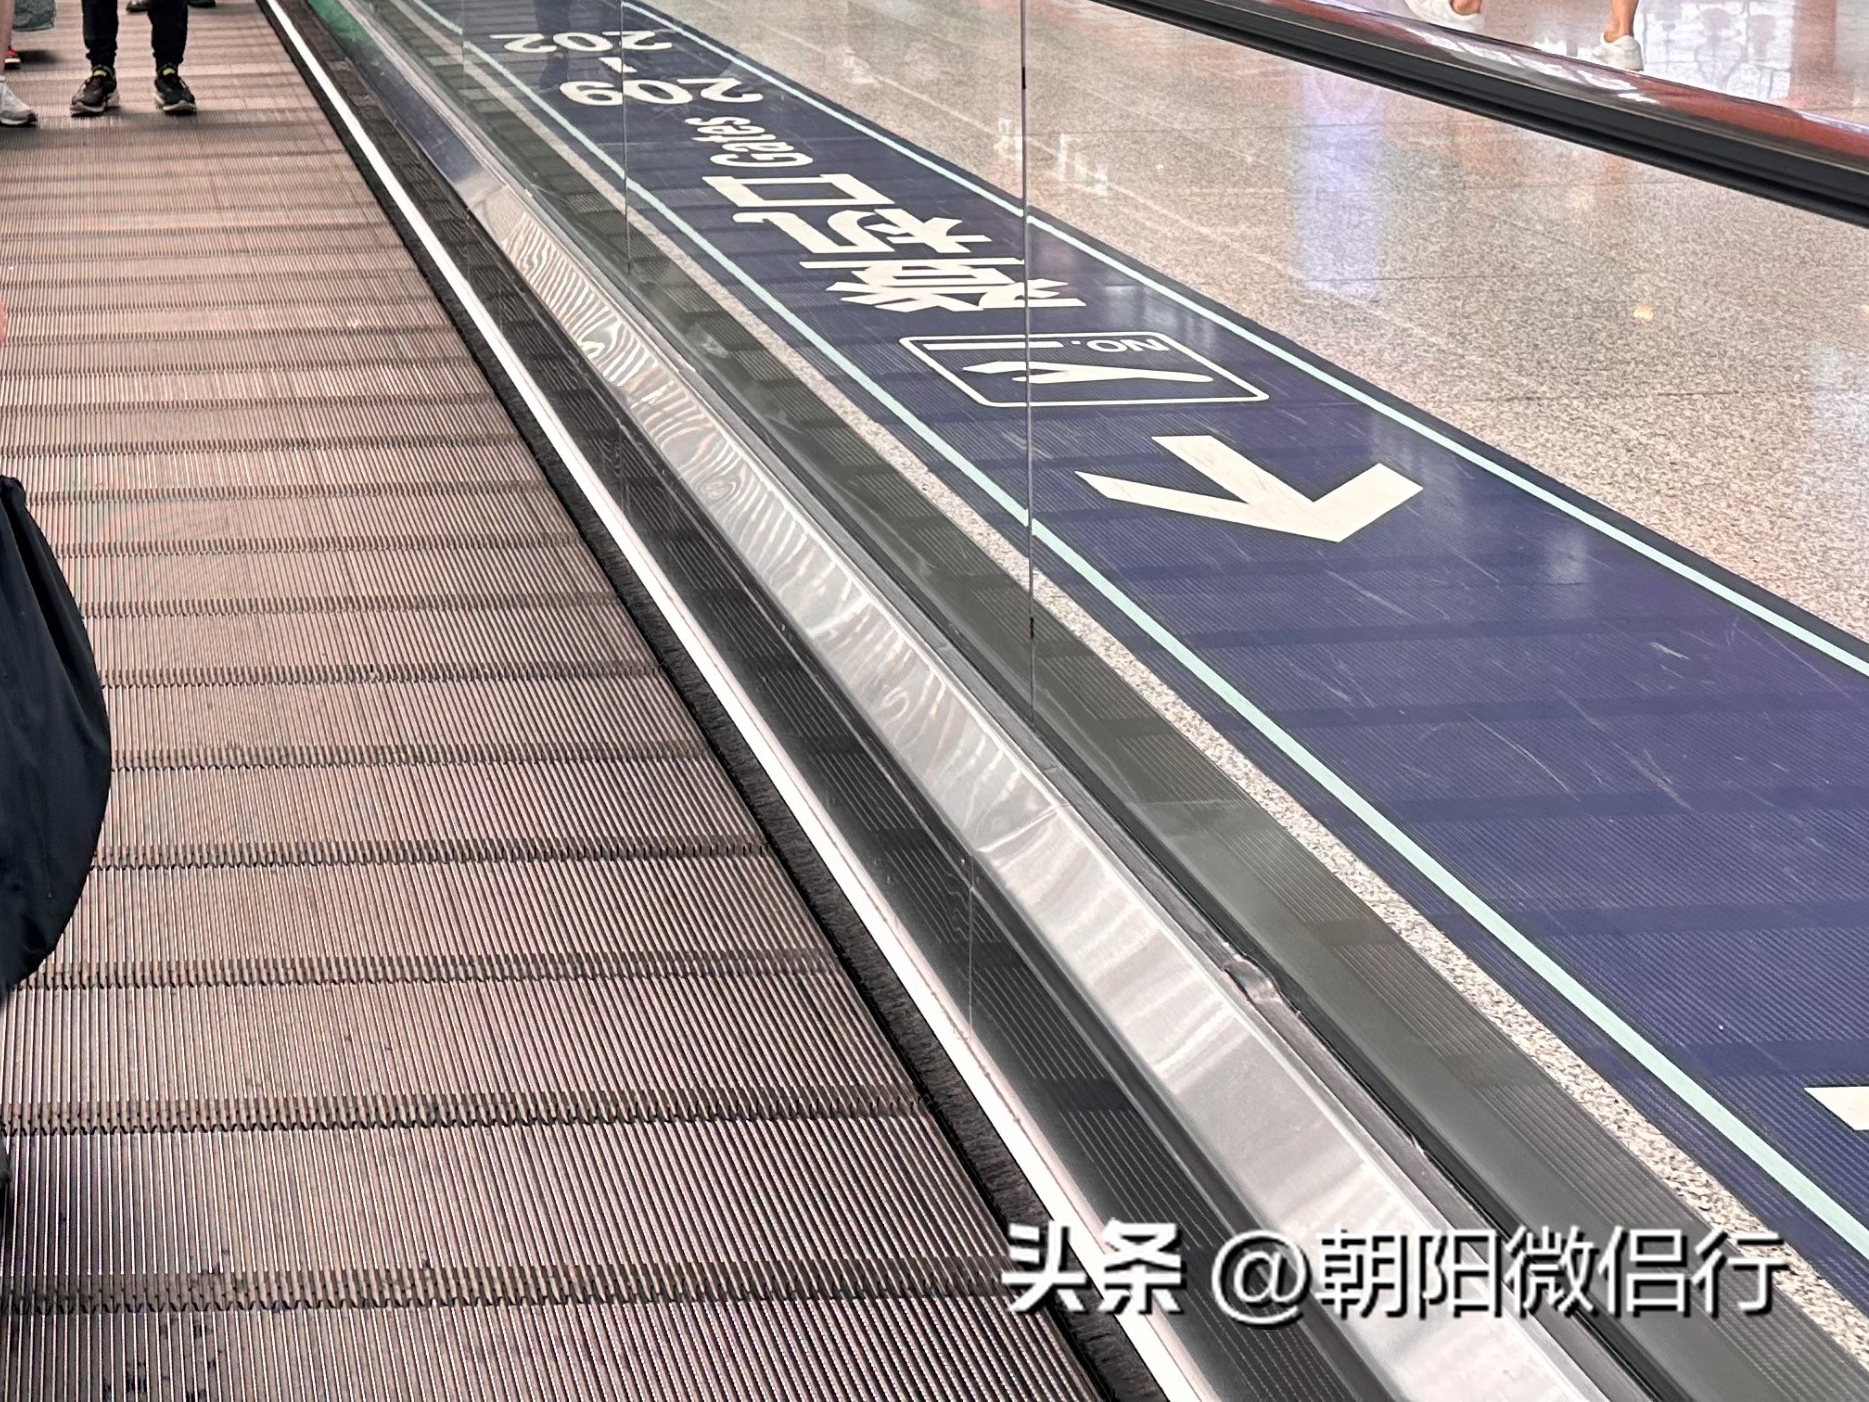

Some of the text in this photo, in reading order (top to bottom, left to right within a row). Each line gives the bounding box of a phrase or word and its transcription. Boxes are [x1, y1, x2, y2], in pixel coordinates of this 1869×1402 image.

[488, 30, 673, 53] 202
[559, 78, 764, 106] 209
[685, 116, 814, 168] Gates
[701, 173, 1087, 312] 登机口
